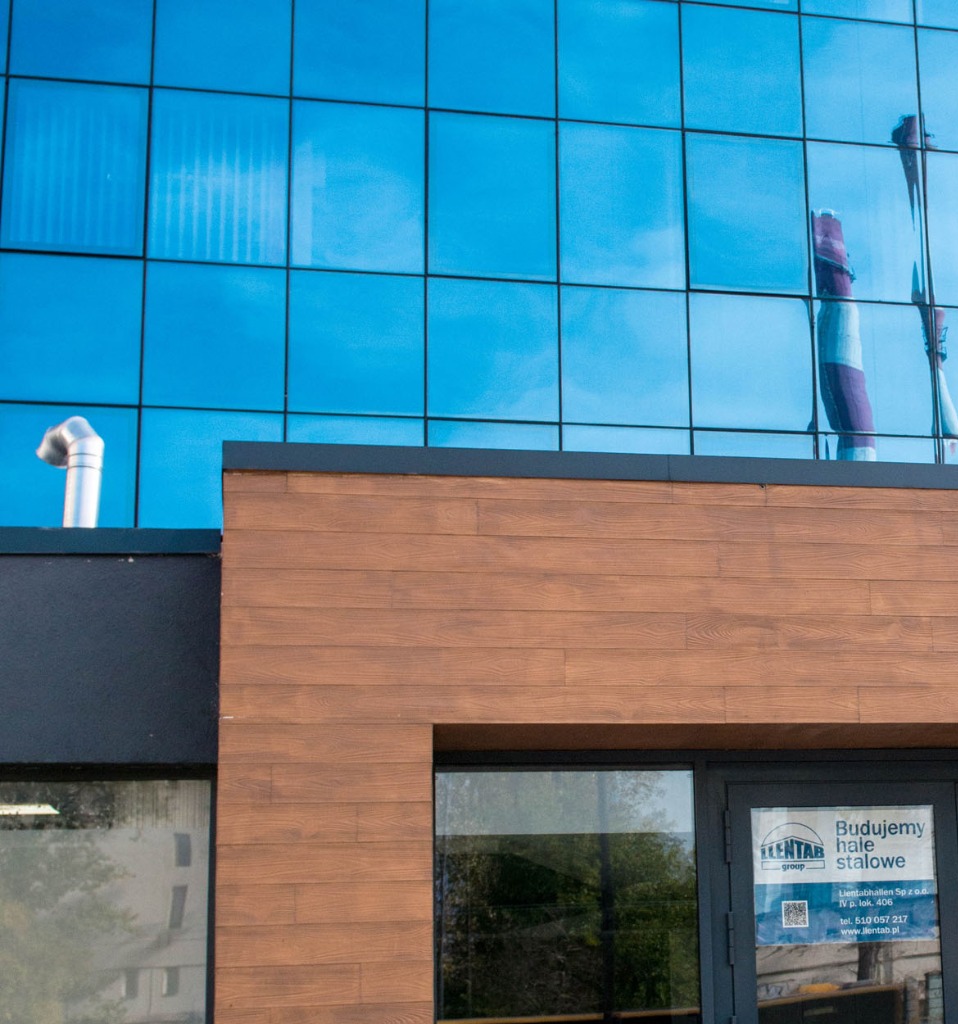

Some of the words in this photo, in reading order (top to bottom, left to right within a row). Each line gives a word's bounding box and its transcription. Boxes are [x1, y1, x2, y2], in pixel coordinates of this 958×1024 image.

[836, 820, 925, 839] Budujemy
[760, 839, 825, 860] LLENTAB
[836, 837, 875, 853] hale
[836, 853, 906, 870] stalowe
[781, 863, 805, 871] group
[839, 888, 894, 897] Llentabhallen
[876, 898, 893, 906] 406
[840, 917, 853, 925] tel.
[855, 916, 871, 924] 510
[873, 916, 890, 924] 057
[892, 915, 908, 923] 217
[840, 926, 900, 935] www.llentab.pl
